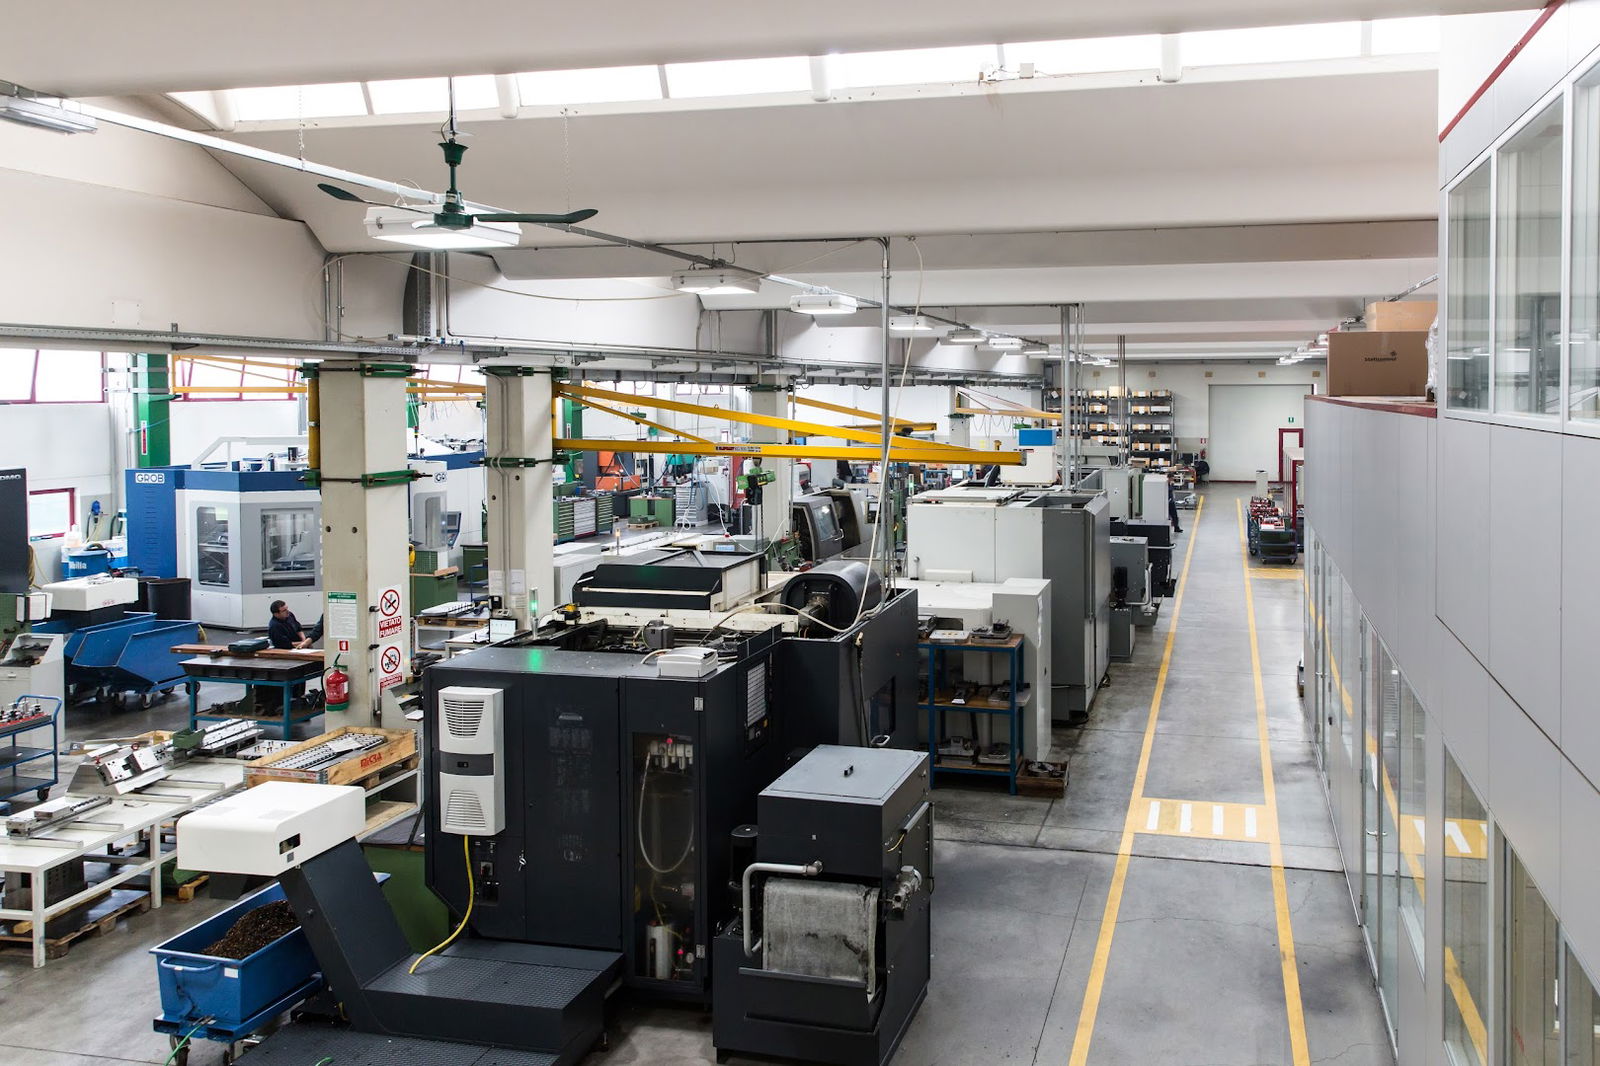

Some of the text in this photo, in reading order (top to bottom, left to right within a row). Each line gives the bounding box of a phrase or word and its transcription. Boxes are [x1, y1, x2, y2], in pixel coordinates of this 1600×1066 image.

[136, 473, 164, 483] GROB
[380, 616, 401, 629] VIETATO
[379, 624, 402, 638] FUMARE
